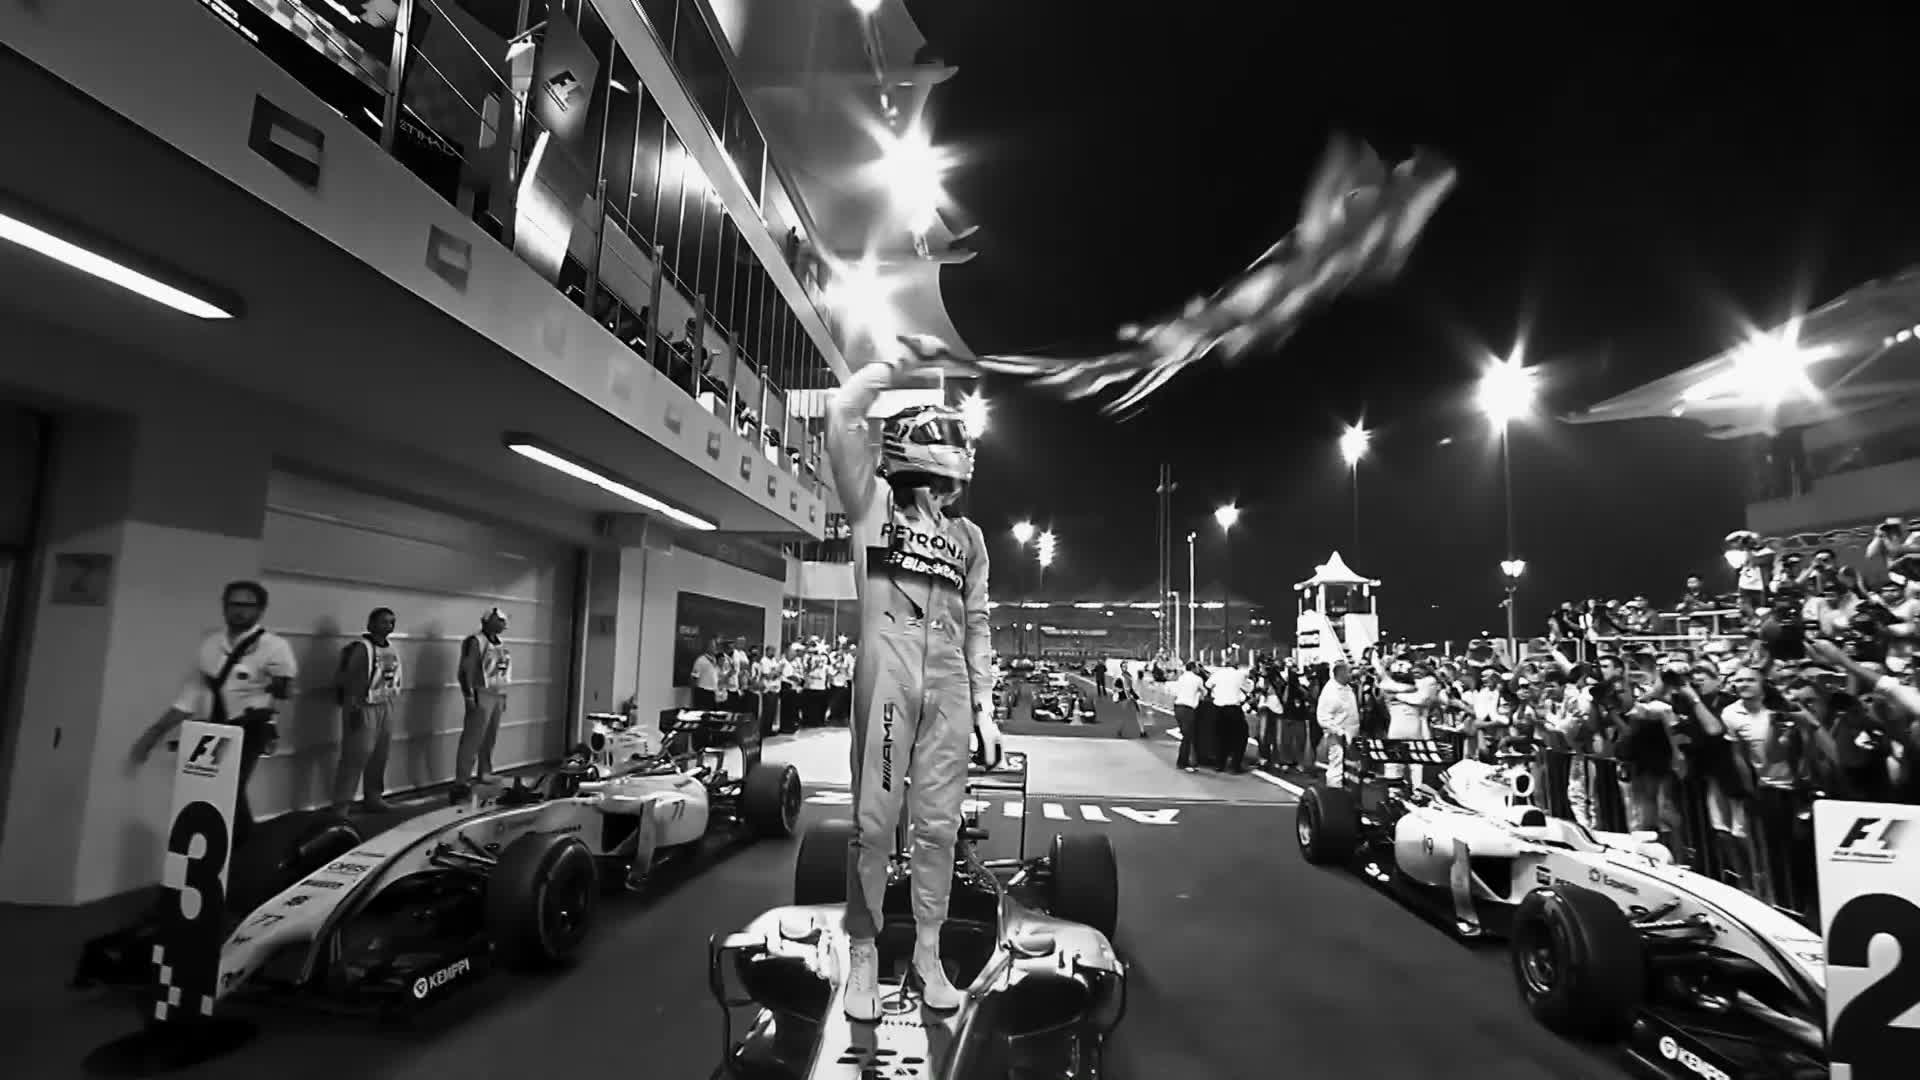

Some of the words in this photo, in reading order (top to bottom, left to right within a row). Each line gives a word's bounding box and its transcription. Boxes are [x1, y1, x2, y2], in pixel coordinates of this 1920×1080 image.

[162, 801, 228, 938] 3
[1838, 817, 1910, 850] F1
[1828, 893, 1920, 1065] 2
